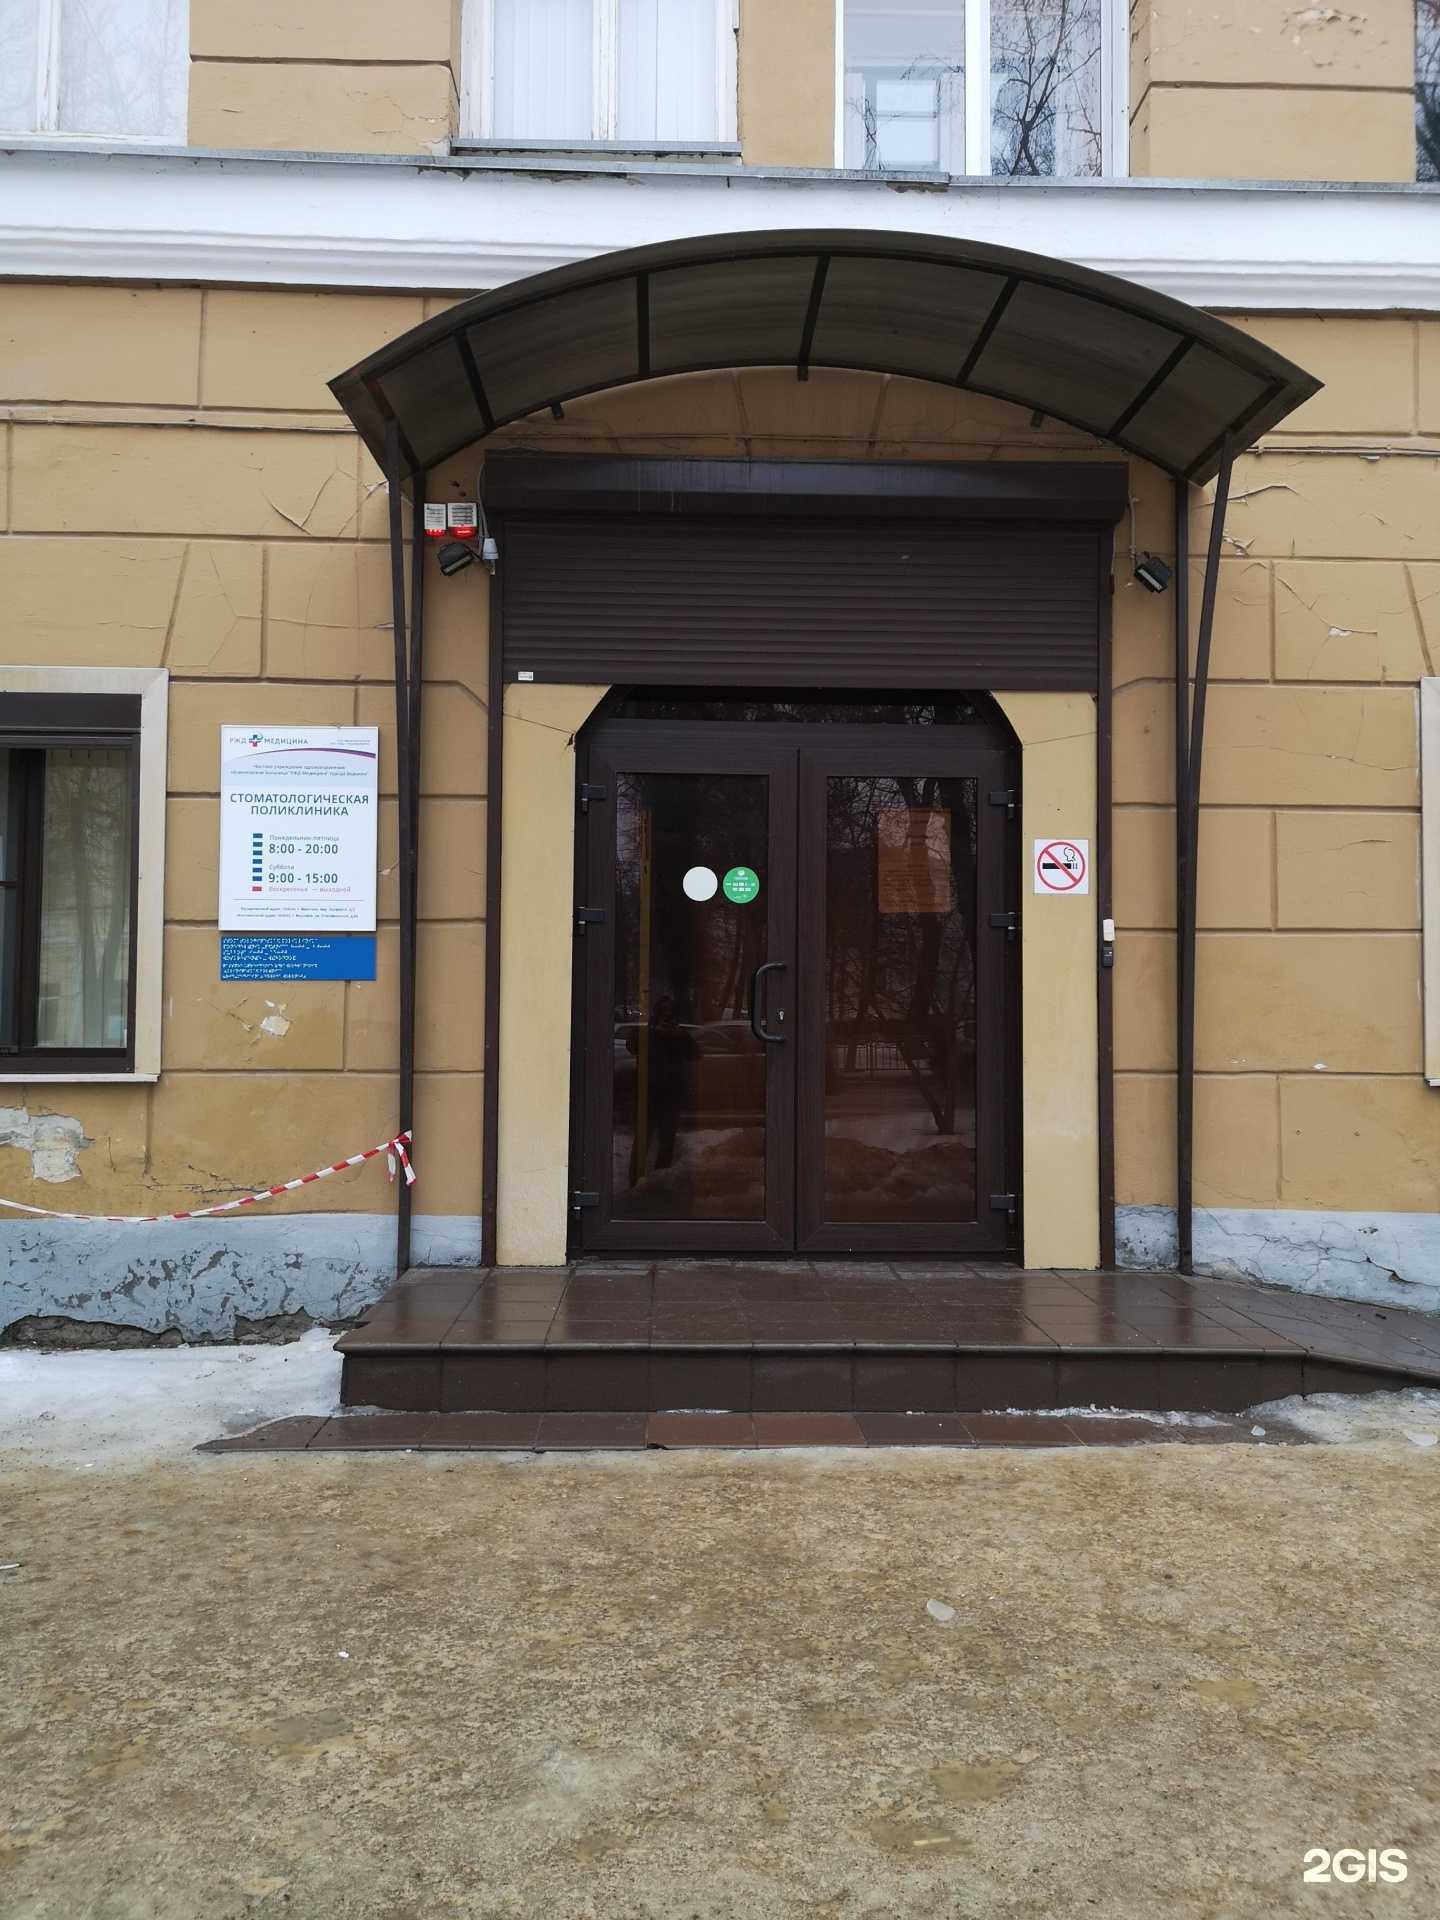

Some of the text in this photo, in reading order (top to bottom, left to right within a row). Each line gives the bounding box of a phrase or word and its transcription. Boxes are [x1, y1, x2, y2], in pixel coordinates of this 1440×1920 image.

[229, 736, 309, 745] РЖД МЕДИЦИНА
[230, 793, 369, 805] СТОМАТОЛОГИЧЕСКАЯ
[251, 805, 349, 816] ПОЛИКЛИНИКА
[269, 843, 295, 854] 8:00
[305, 843, 338, 854] 20:00
[268, 872, 294, 883] 9:00
[305, 873, 338, 884] 15:00
